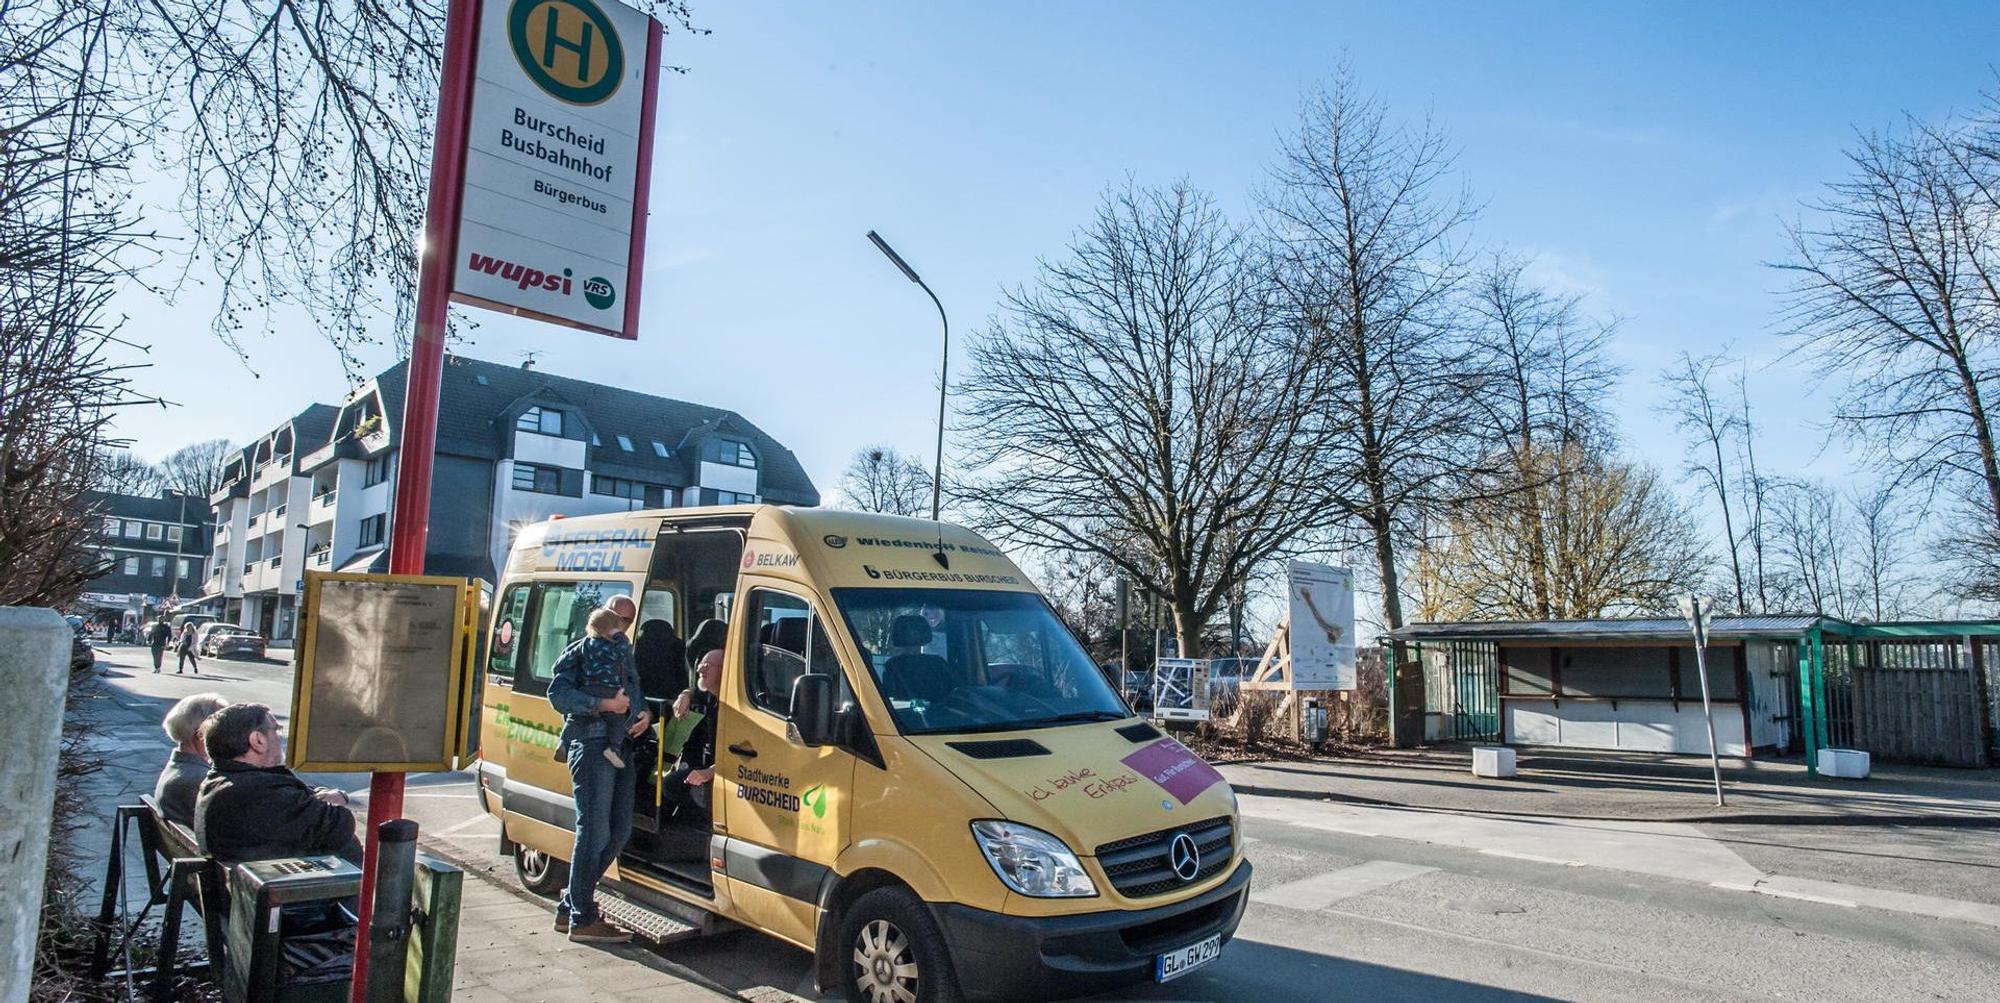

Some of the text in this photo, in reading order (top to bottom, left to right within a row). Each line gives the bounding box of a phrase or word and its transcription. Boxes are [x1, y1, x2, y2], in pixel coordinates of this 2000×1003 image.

[543, 7, 593, 82] H
[514, 107, 605, 156] Burscheid
[501, 129, 613, 183] Busbahnhof
[534, 180, 607, 214] Bürgerbus
[469, 252, 573, 296] wupsi
[584, 279, 608, 296] VRS
[562, 528, 653, 549] FEDERAL
[555, 551, 625, 571] MOGUL
[757, 553, 800, 567] BELKAW
[883, 569, 963, 582] BÜRGERBUS
[737, 764, 790, 789] Stadtwerke
[737, 784, 801, 812] BURSCHEID
[1164, 954, 1180, 975] GL
[1202, 936, 1220, 961] 299
